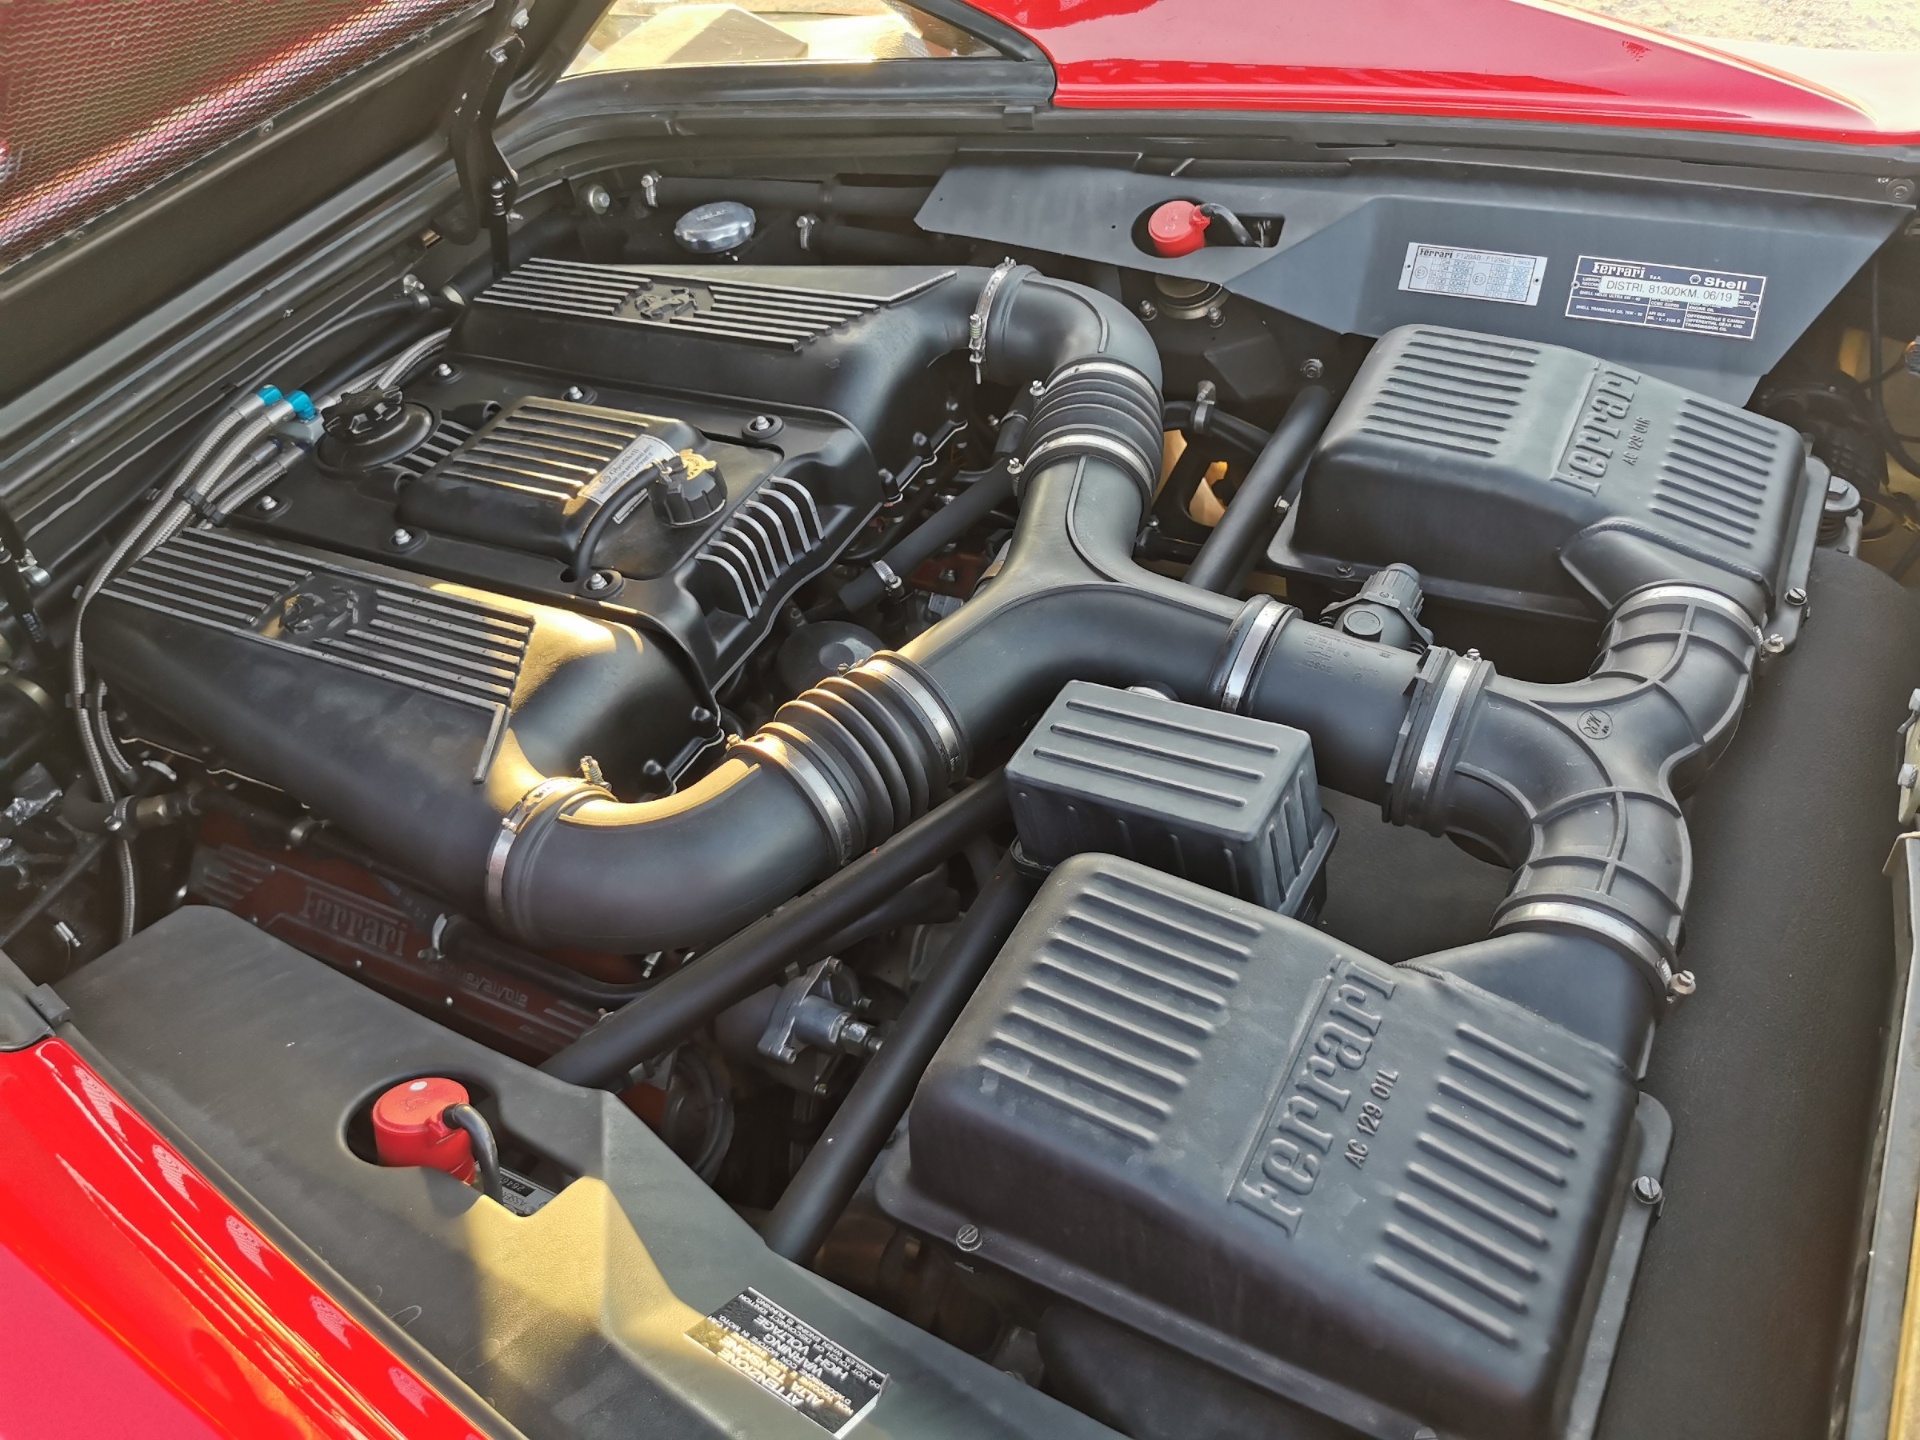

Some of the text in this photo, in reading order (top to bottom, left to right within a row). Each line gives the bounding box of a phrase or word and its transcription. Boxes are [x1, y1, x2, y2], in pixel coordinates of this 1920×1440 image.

[1419, 247, 1453, 258] Ferrari
[1591, 261, 1646, 278] Ferrari
[1606, 279, 1732, 302] DISTRI. 81300KM. 06/19
[1702, 276, 1747, 290] Shell
[1550, 363, 1641, 496] Ferrari
[298, 887, 411, 957] Ferrari
[1228, 954, 1397, 1238] Ferrari
[1356, 1101, 1384, 1137] 129
[1344, 1139, 1369, 1170] AC
[768, 1313, 812, 1343] DISCONNECT
[749, 1335, 780, 1356] MOTORE
[752, 1314, 849, 1378] HIGH VOLTAGE
[761, 1333, 824, 1375] WARNING
[820, 1341, 843, 1356] WHEN
[717, 1335, 825, 1407] ALTA TENSIONE
[779, 1355, 798, 1369] CON
[824, 1350, 851, 1368] TOUCH
[844, 1356, 873, 1375] CABLES
[716, 1347, 804, 1406] ATTENZIONE
[850, 1367, 868, 1380] NOT
